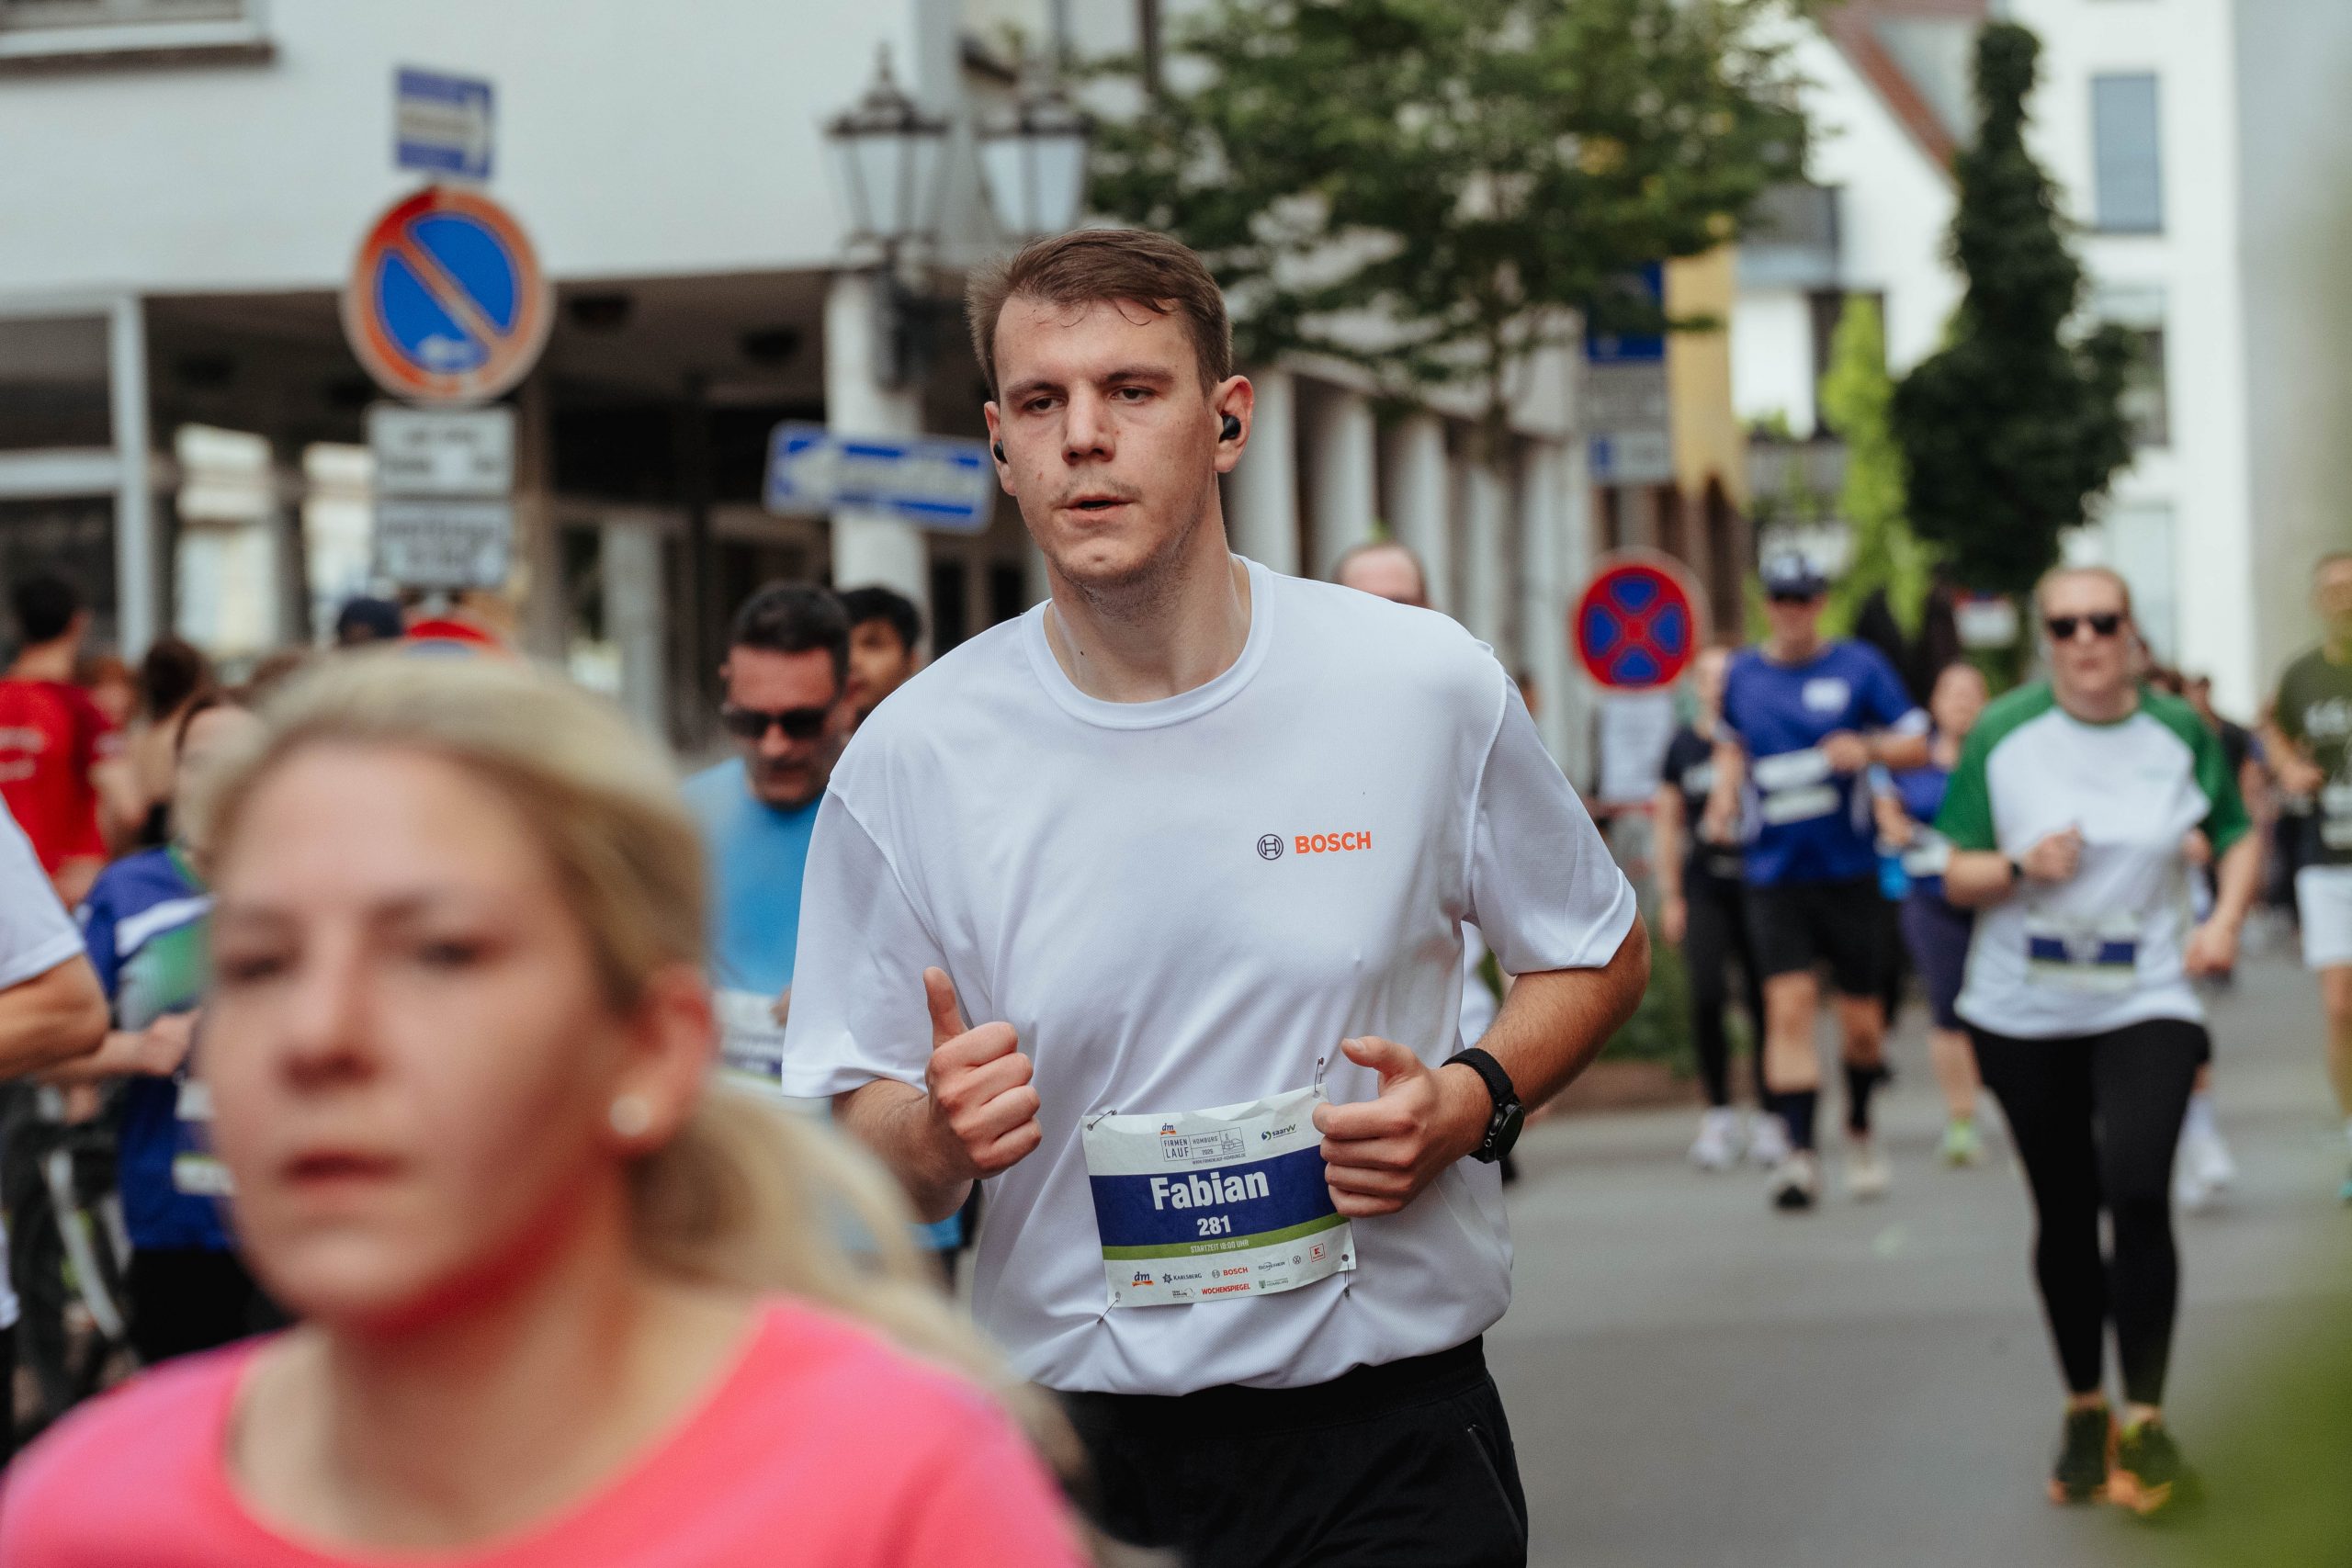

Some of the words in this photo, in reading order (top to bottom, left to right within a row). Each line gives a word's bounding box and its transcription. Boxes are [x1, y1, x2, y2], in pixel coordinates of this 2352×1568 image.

[1295, 831, 1372, 854] BOSCH
[1162, 1122, 1174, 1131] dm
[1163, 1138, 1188, 1146] FIRMEN
[1193, 1135, 1218, 1145] HOMBURG
[1165, 1146, 1189, 1158] LAUF
[1150, 1170, 1270, 1211] Fabian
[1197, 1215, 1231, 1236] 281
[1190, 1243, 1219, 1254] STARTZEIT
[1236, 1239, 1250, 1248] UHR
[1134, 1270, 1150, 1281] dm
[1172, 1272, 1203, 1280] KARLSBERG
[1223, 1267, 1249, 1276] BOSCH
[1202, 1283, 1250, 1295] WOCHENSPIEGEL
